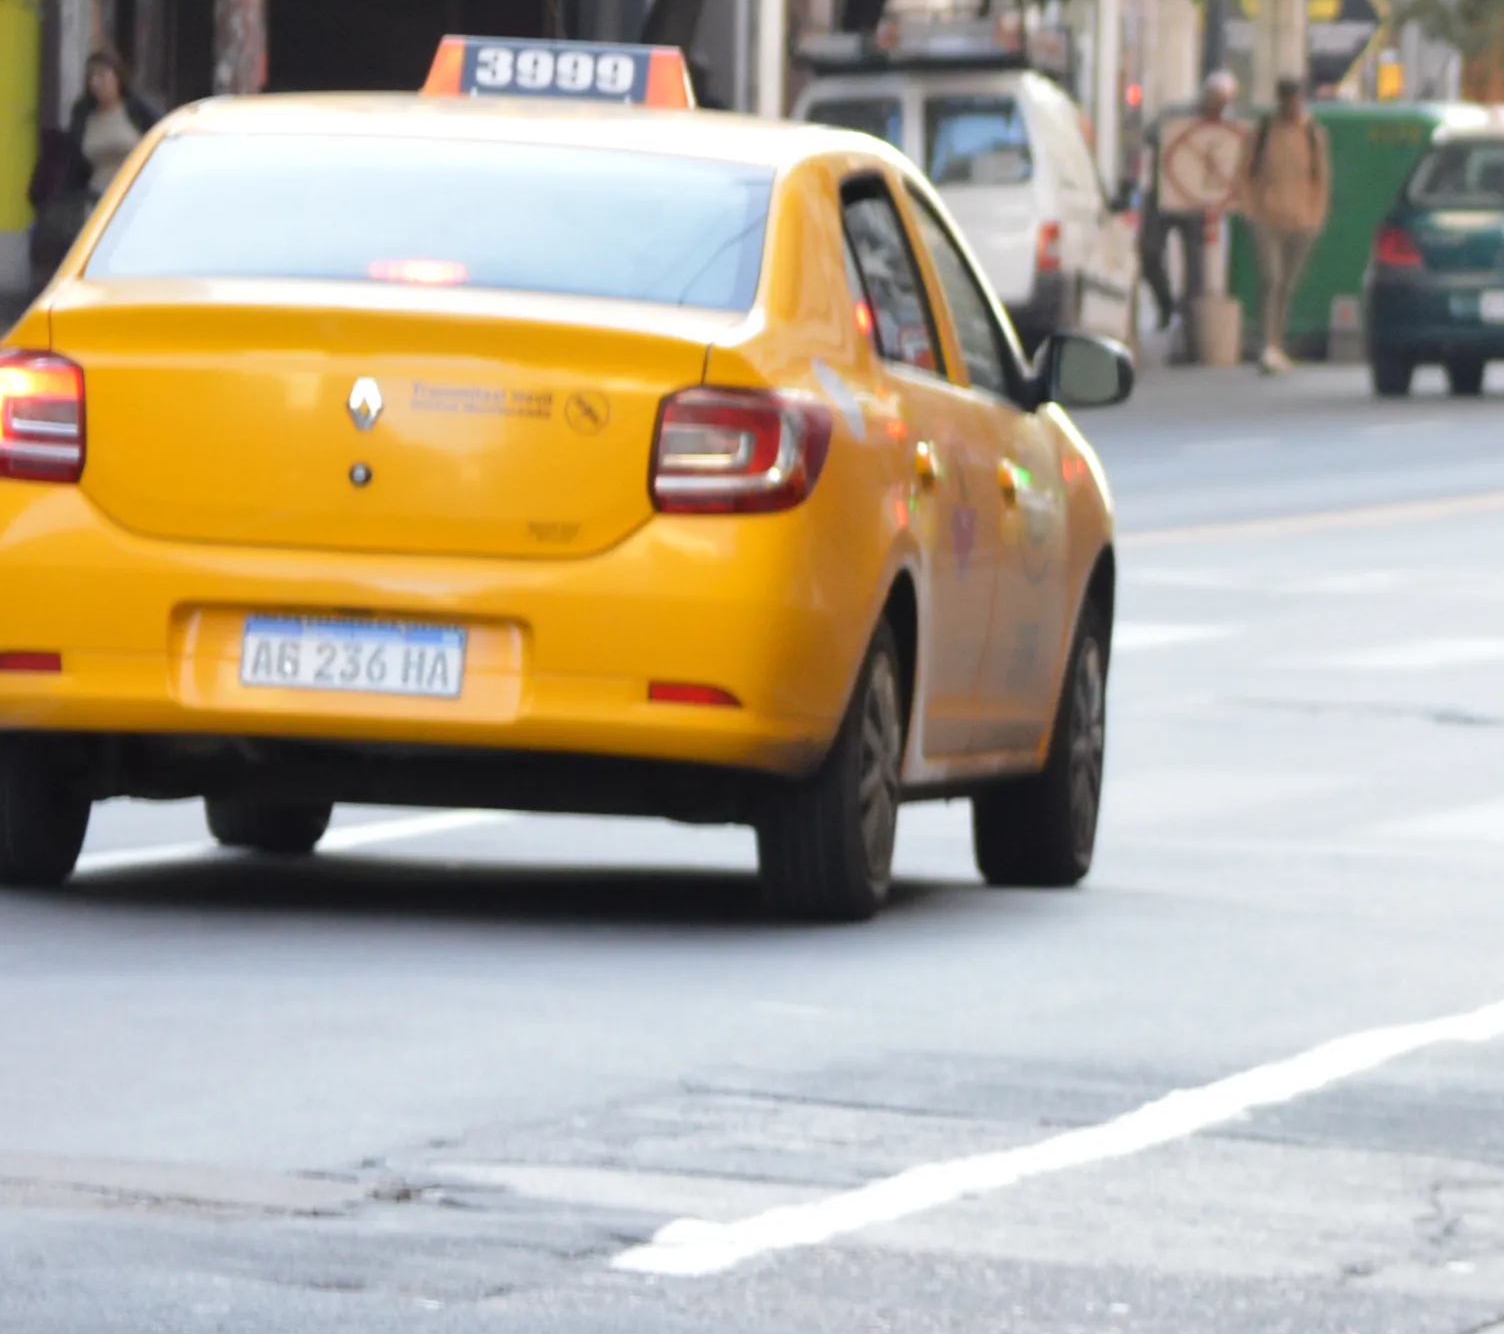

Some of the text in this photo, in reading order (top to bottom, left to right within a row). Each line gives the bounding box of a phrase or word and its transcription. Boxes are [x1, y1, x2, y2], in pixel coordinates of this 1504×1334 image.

[475, 47, 636, 92] 3999
[313, 642, 389, 685] 236
[401, 647, 449, 689] HA
